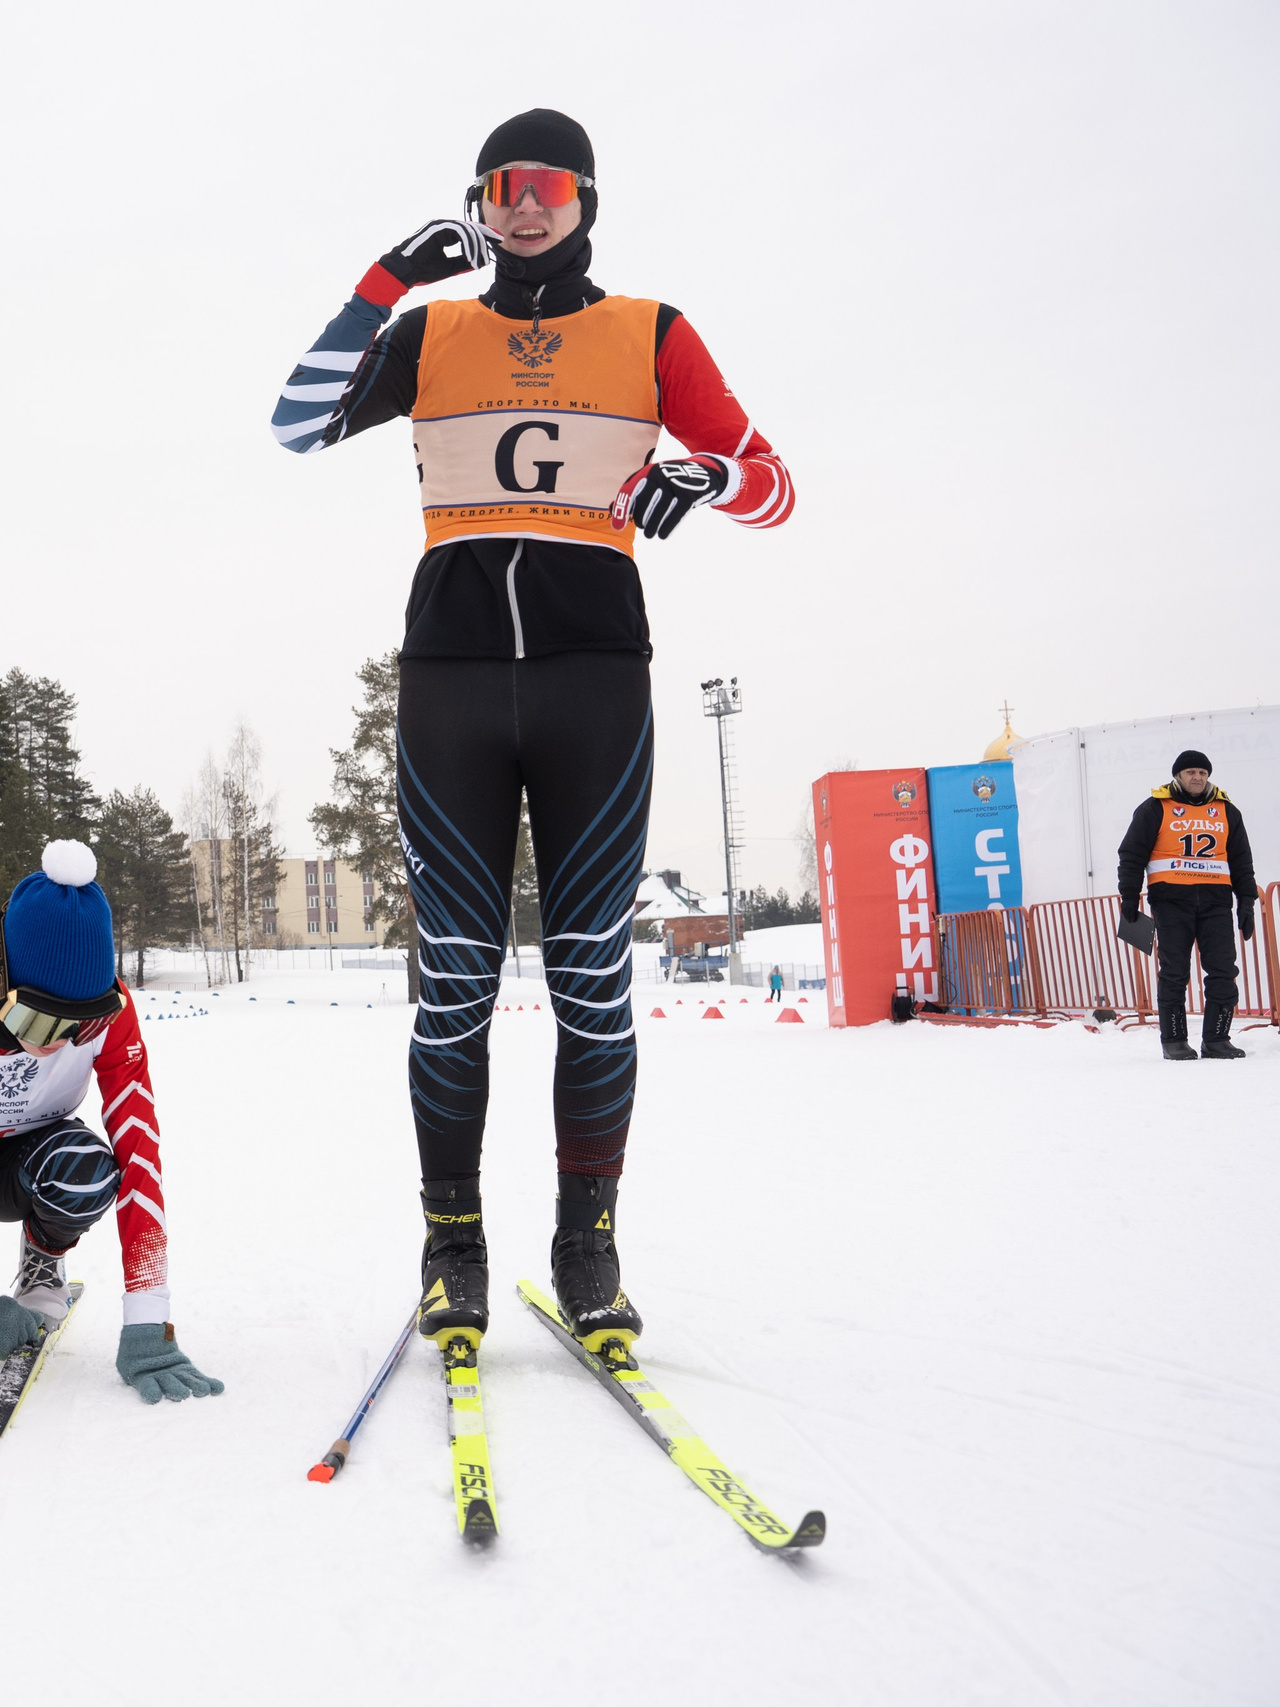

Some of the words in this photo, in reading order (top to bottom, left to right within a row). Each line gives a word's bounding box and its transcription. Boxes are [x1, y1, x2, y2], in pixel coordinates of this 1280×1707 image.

[477, 400, 523, 409] СПОРТ
[569, 402, 598, 410] МЫ!
[495, 421, 564, 493] G
[460, 506, 520, 517] СПОРТЕ.
[529, 506, 571, 516] ЖИВИ
[874, 810, 917, 818] МИНИСТЕРСТВО
[953, 806, 997, 814] МИНИСТЕРСТВО
[1170, 820, 1224, 832] СУДЬЯ
[1179, 832, 1218, 858] 12
[1184, 861, 1205, 870] ПСБ
[824, 840, 843, 1007] ФИНИШ
[6, 1116, 32, 1124] ЭТО
[40, 1108, 66, 1118] МЫ!
[425, 1211, 481, 1224] FISCHER
[696, 1467, 789, 1536] FISCHER
